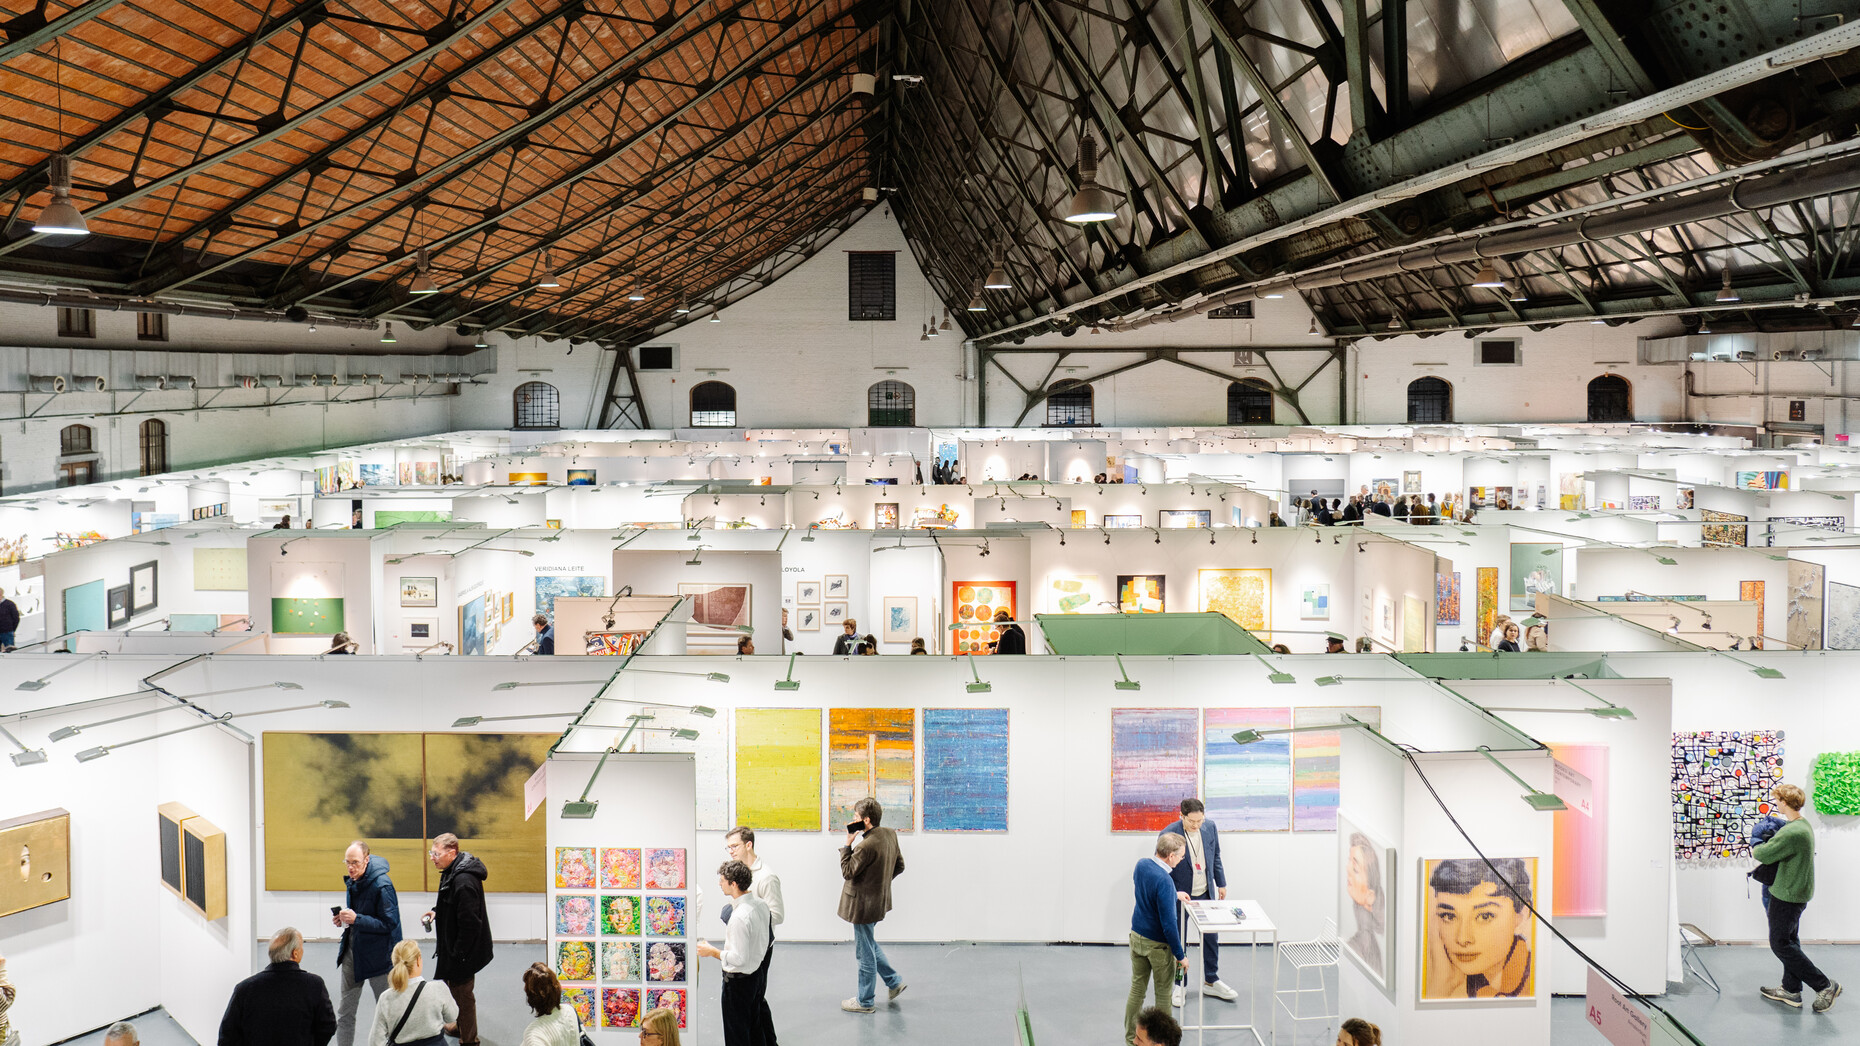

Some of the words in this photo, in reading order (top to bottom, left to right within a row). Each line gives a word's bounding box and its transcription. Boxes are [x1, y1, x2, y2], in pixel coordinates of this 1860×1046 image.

[1581, 799, 1590, 811] A4
[1589, 1005, 1602, 1026] A5
[1622, 1004, 1630, 1014] Art
[1630, 1010, 1647, 1030] Gallery
